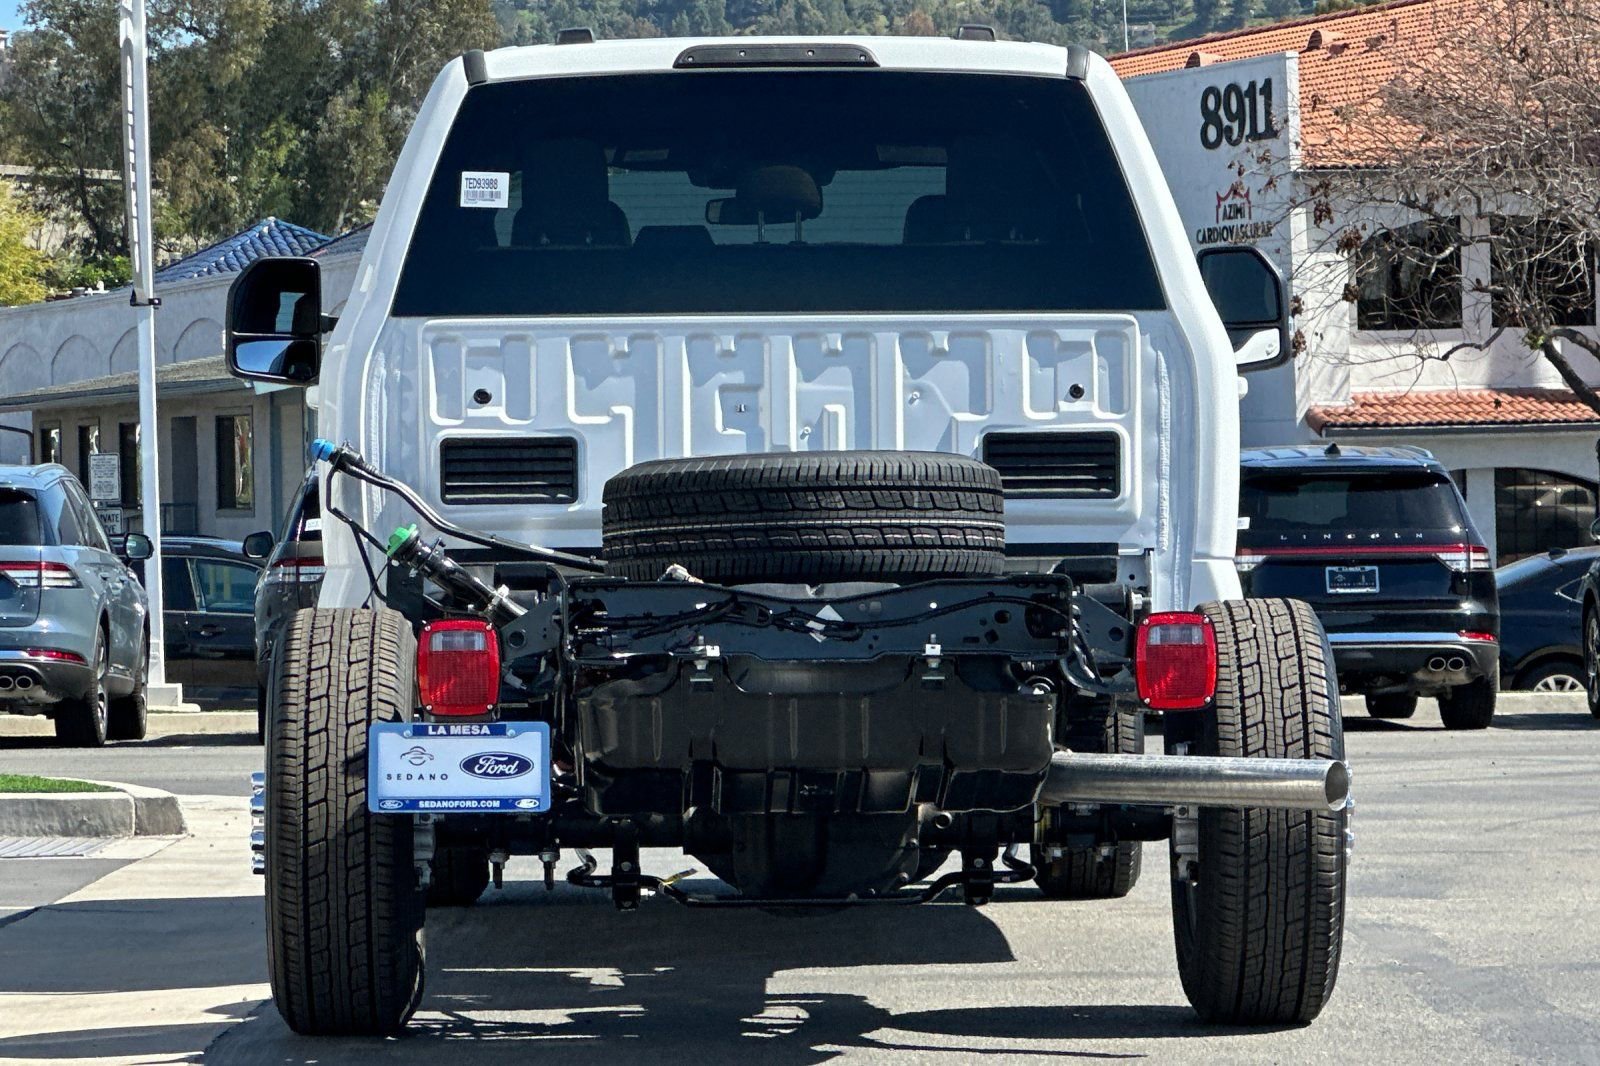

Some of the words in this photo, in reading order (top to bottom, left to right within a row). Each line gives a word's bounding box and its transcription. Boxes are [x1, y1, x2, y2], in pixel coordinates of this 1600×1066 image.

[1200, 78, 1278, 149] 8911
[464, 177, 498, 189] TED93988
[1280, 532, 1423, 540] LINCOLN
[428, 725, 446, 735] LA
[450, 725, 491, 735] MESA
[474, 755, 518, 775] Ford
[386, 773, 449, 781] SEDANO
[418, 800, 500, 808] SEDANOFORD.COM
